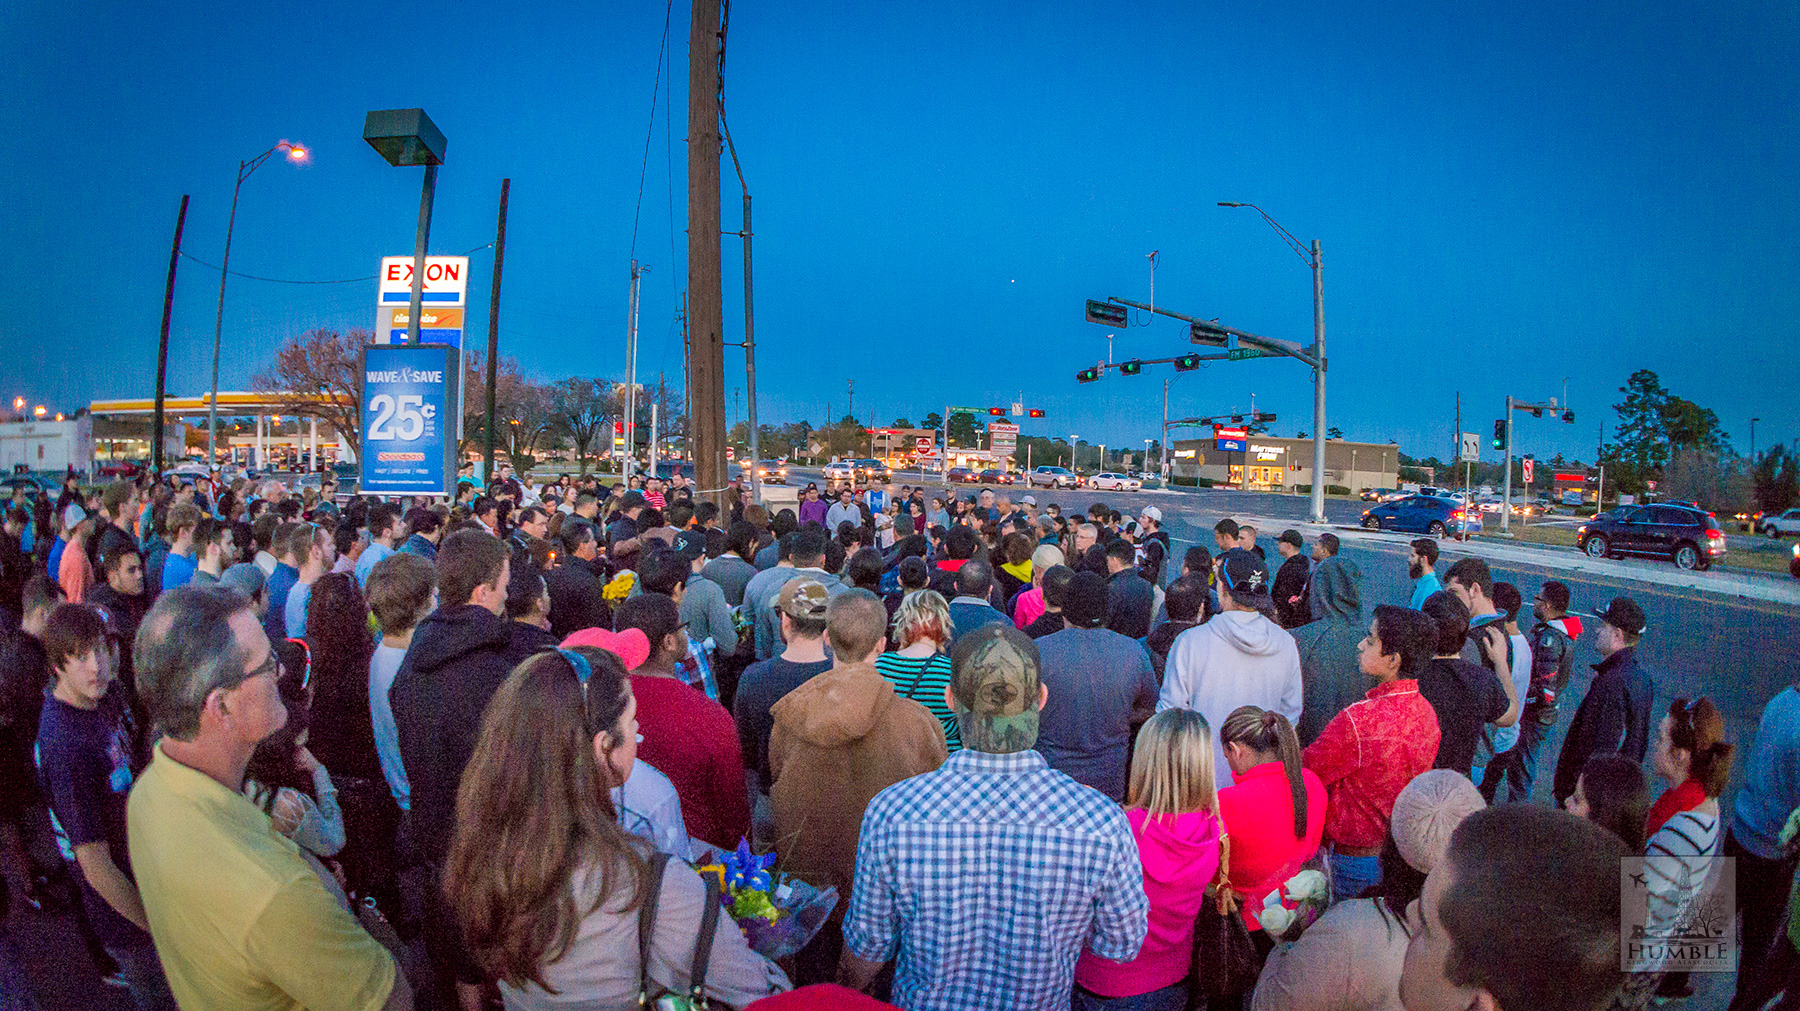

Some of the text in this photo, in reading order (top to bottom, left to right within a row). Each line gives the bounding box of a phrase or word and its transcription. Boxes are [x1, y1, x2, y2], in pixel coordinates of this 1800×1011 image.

[1230, 347, 1261, 360] FM 1960
[366, 371, 398, 383] WAVE
[412, 371, 442, 383] SAVE
